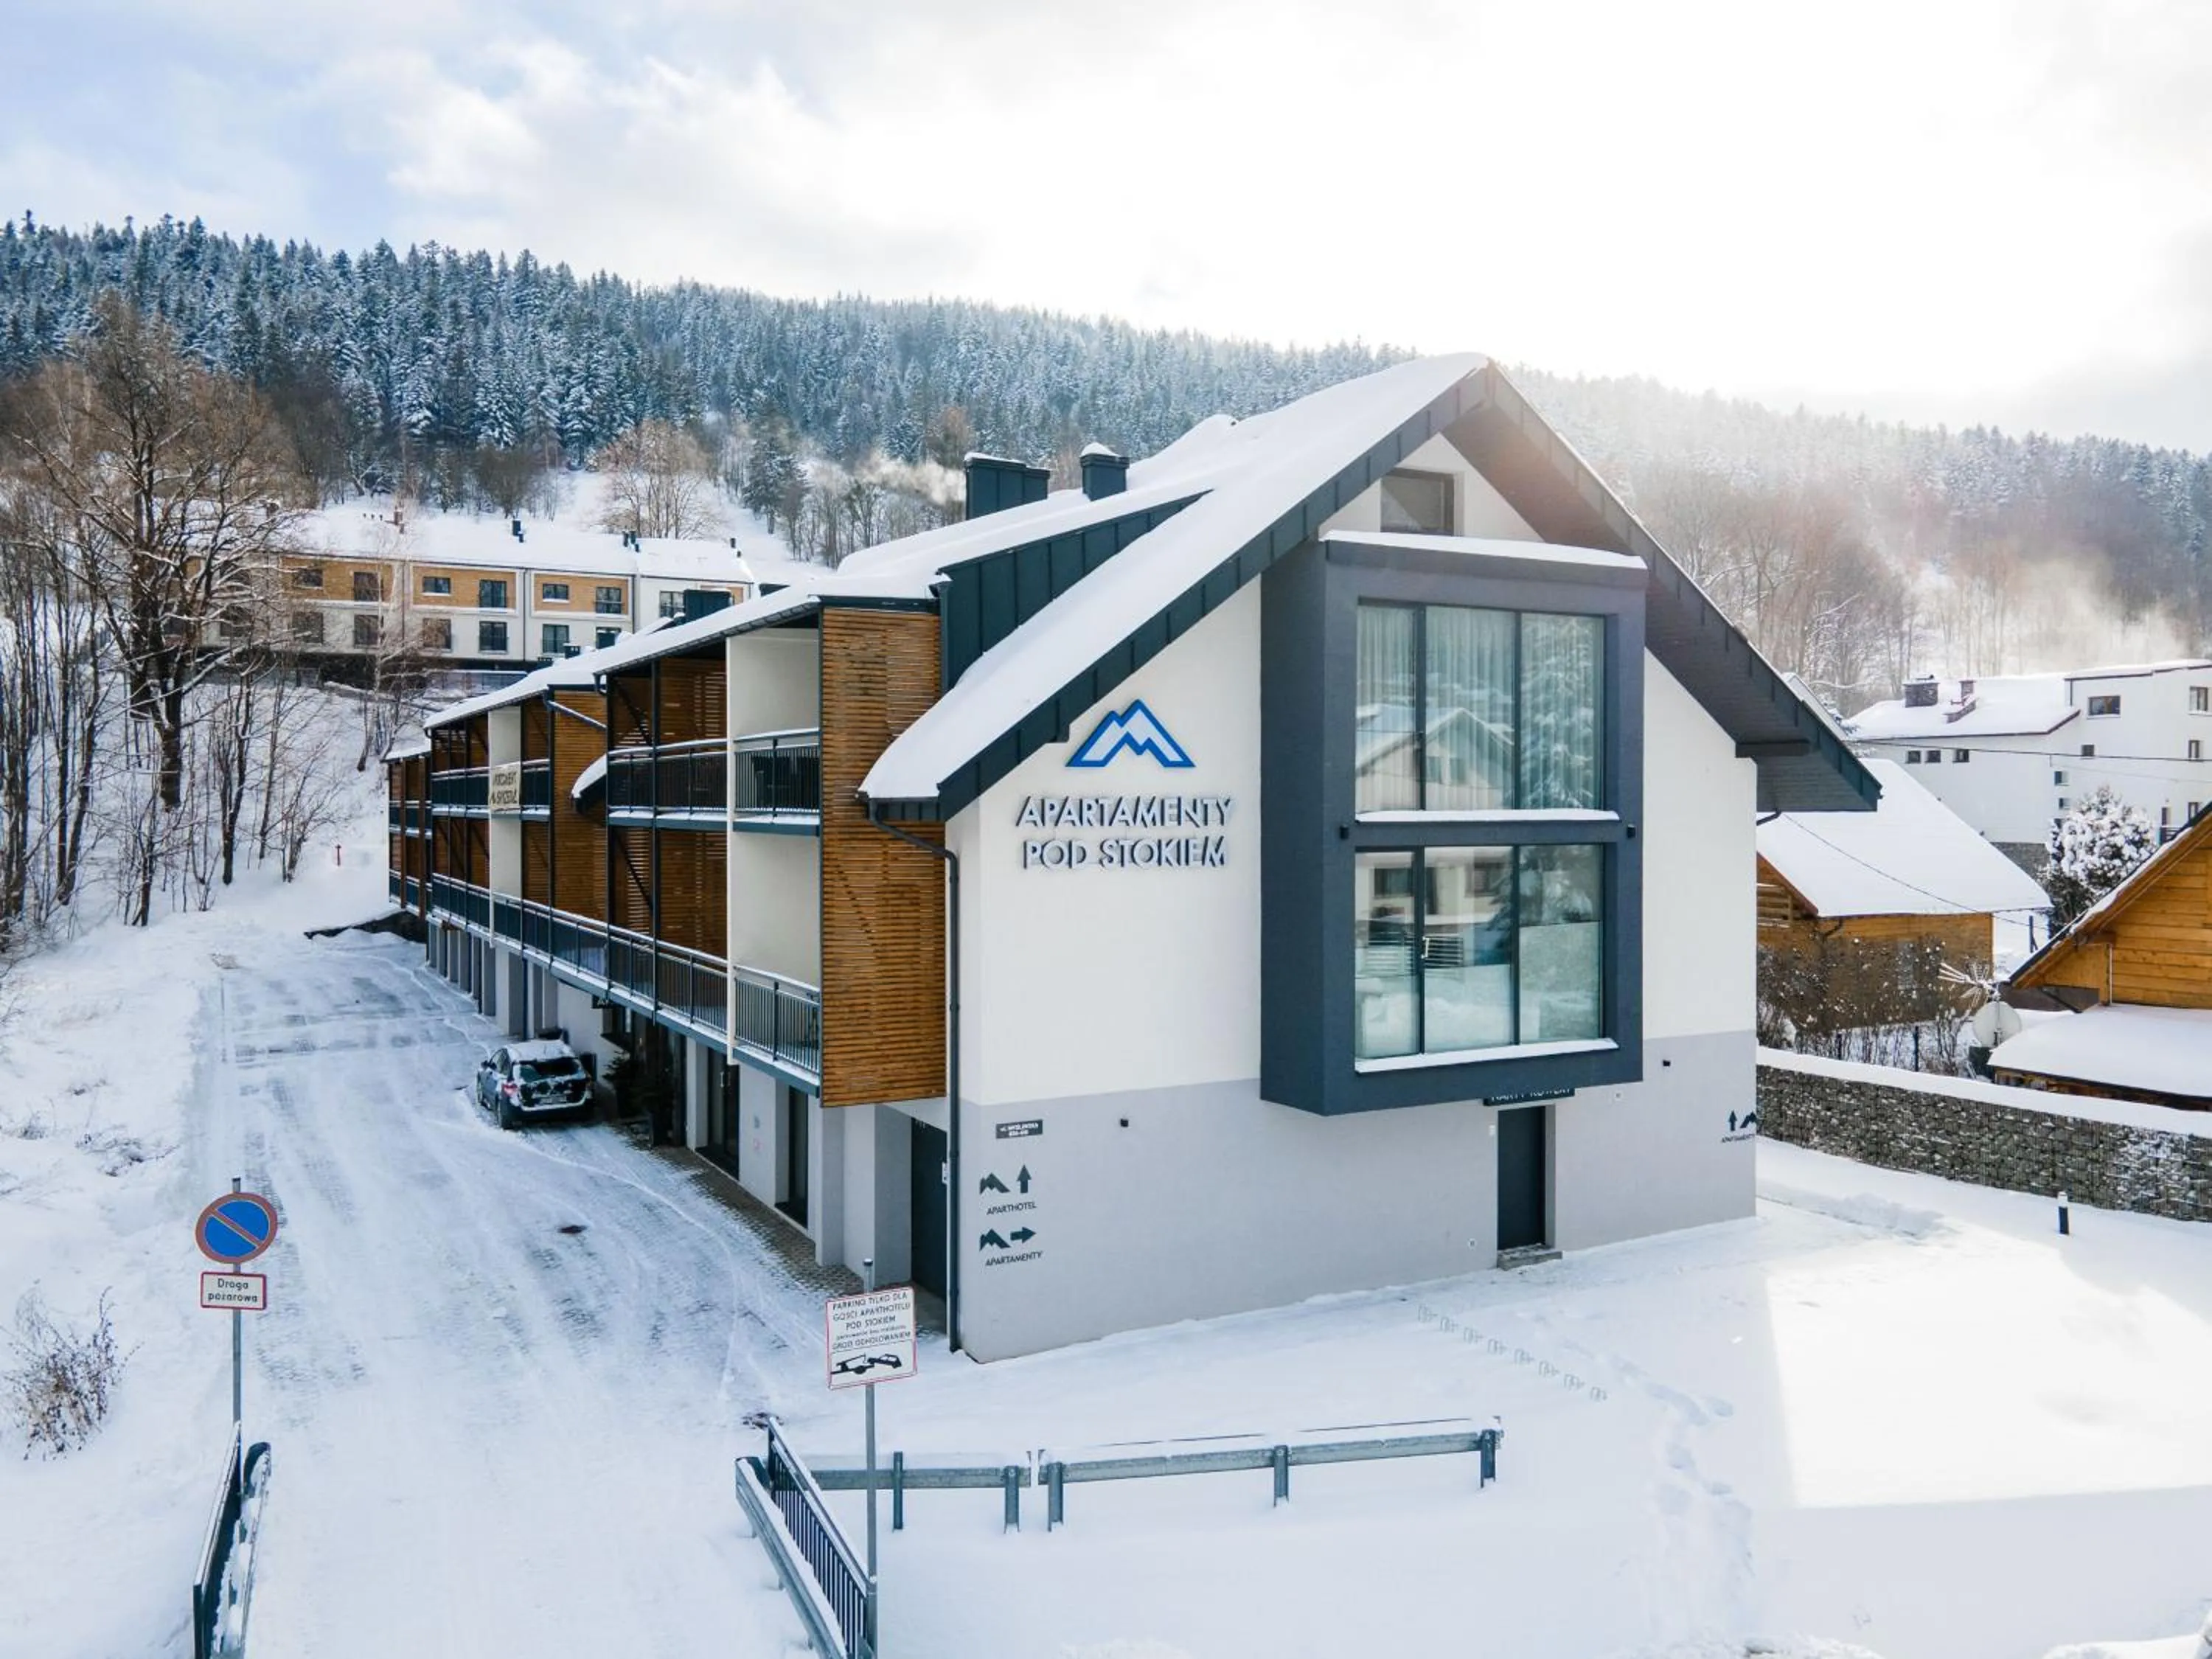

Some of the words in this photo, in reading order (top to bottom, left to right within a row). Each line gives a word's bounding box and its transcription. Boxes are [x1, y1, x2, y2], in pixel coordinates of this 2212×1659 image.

[1015, 796, 1232, 828] APARTAMENTY
[1023, 838, 1090, 869] POD
[1098, 835, 1228, 868] STOKIEM
[986, 1201, 1037, 1215] APARTHOTEL
[985, 1251, 1043, 1267] APARTAMENTY
[218, 1278, 248, 1291] Droga
[833, 1298, 866, 1310] PARKING
[846, 1321, 862, 1330] POD
